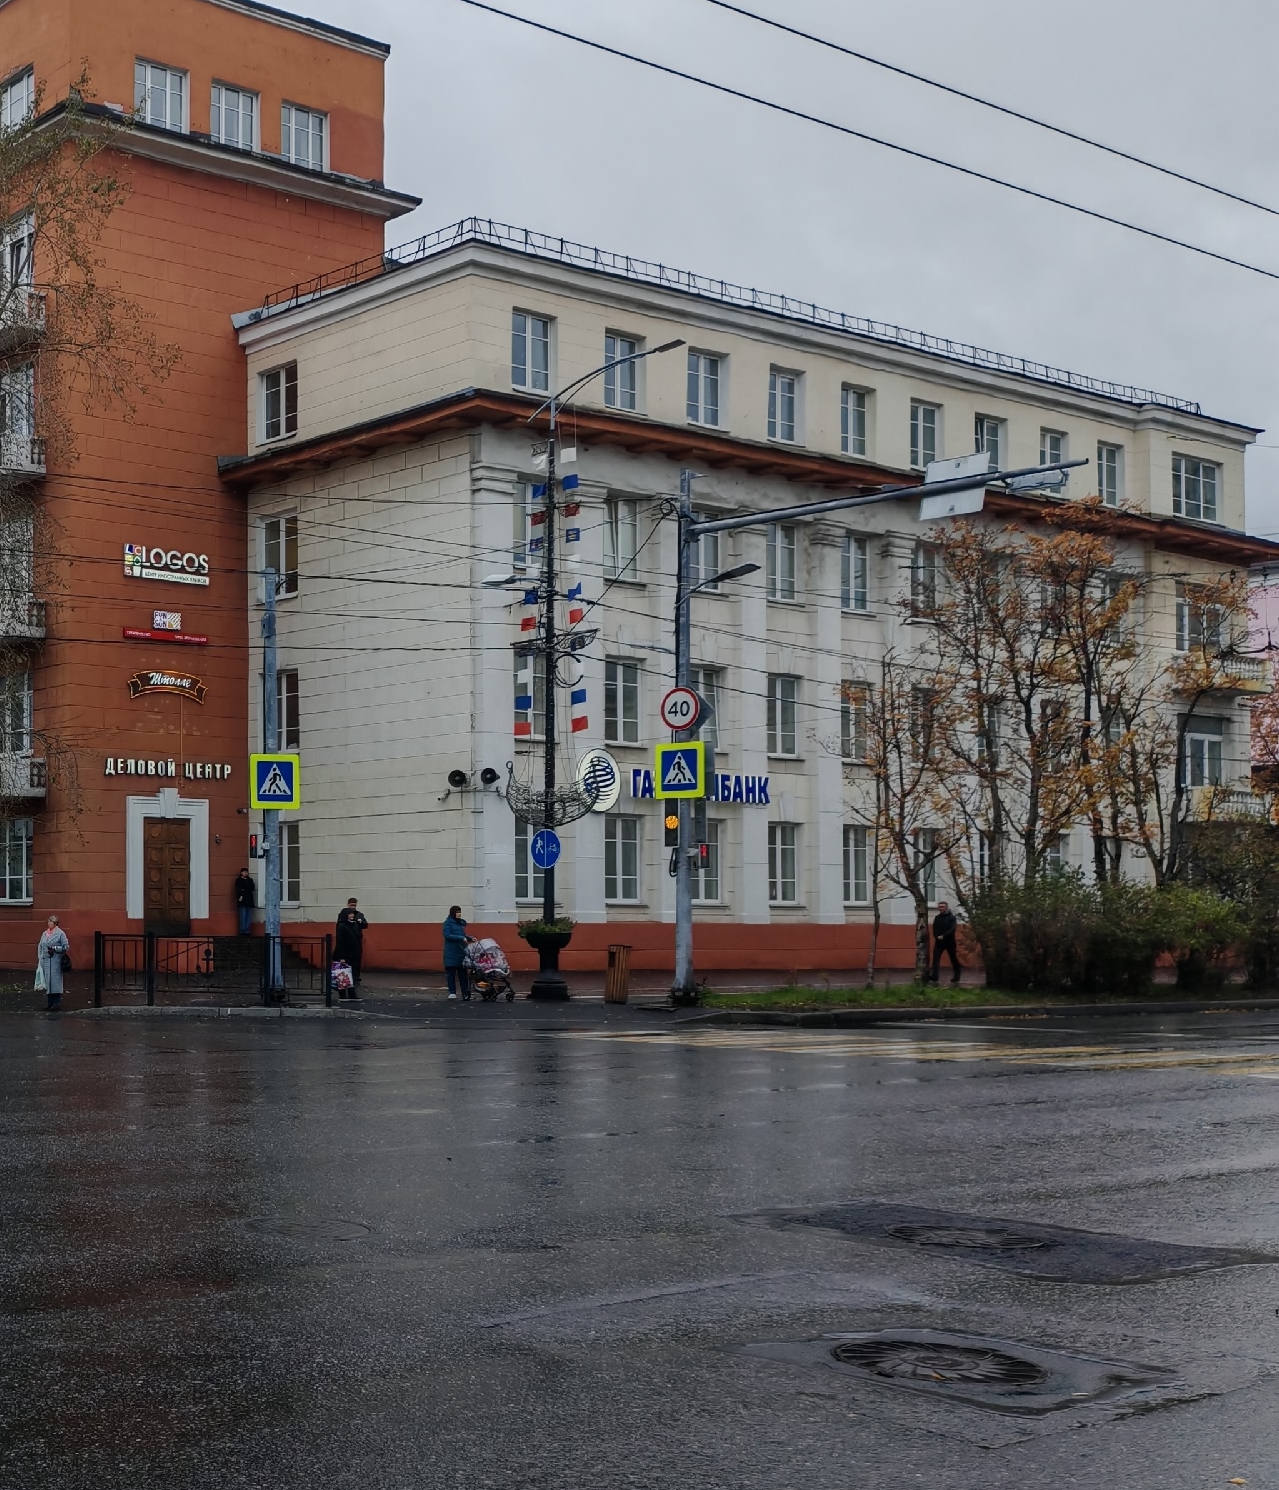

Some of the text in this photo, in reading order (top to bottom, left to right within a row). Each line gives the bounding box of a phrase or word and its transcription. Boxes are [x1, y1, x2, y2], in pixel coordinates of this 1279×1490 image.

[142, 545, 209, 574] LOGOS
[155, 611, 167, 619] FUN
[148, 672, 192, 688] Штолле
[667, 700, 690, 717] 40
[105, 757, 232, 780] ДЕЛОВОЙ ЦЕНТР
[631, 768, 770, 804] ГАБАНК
